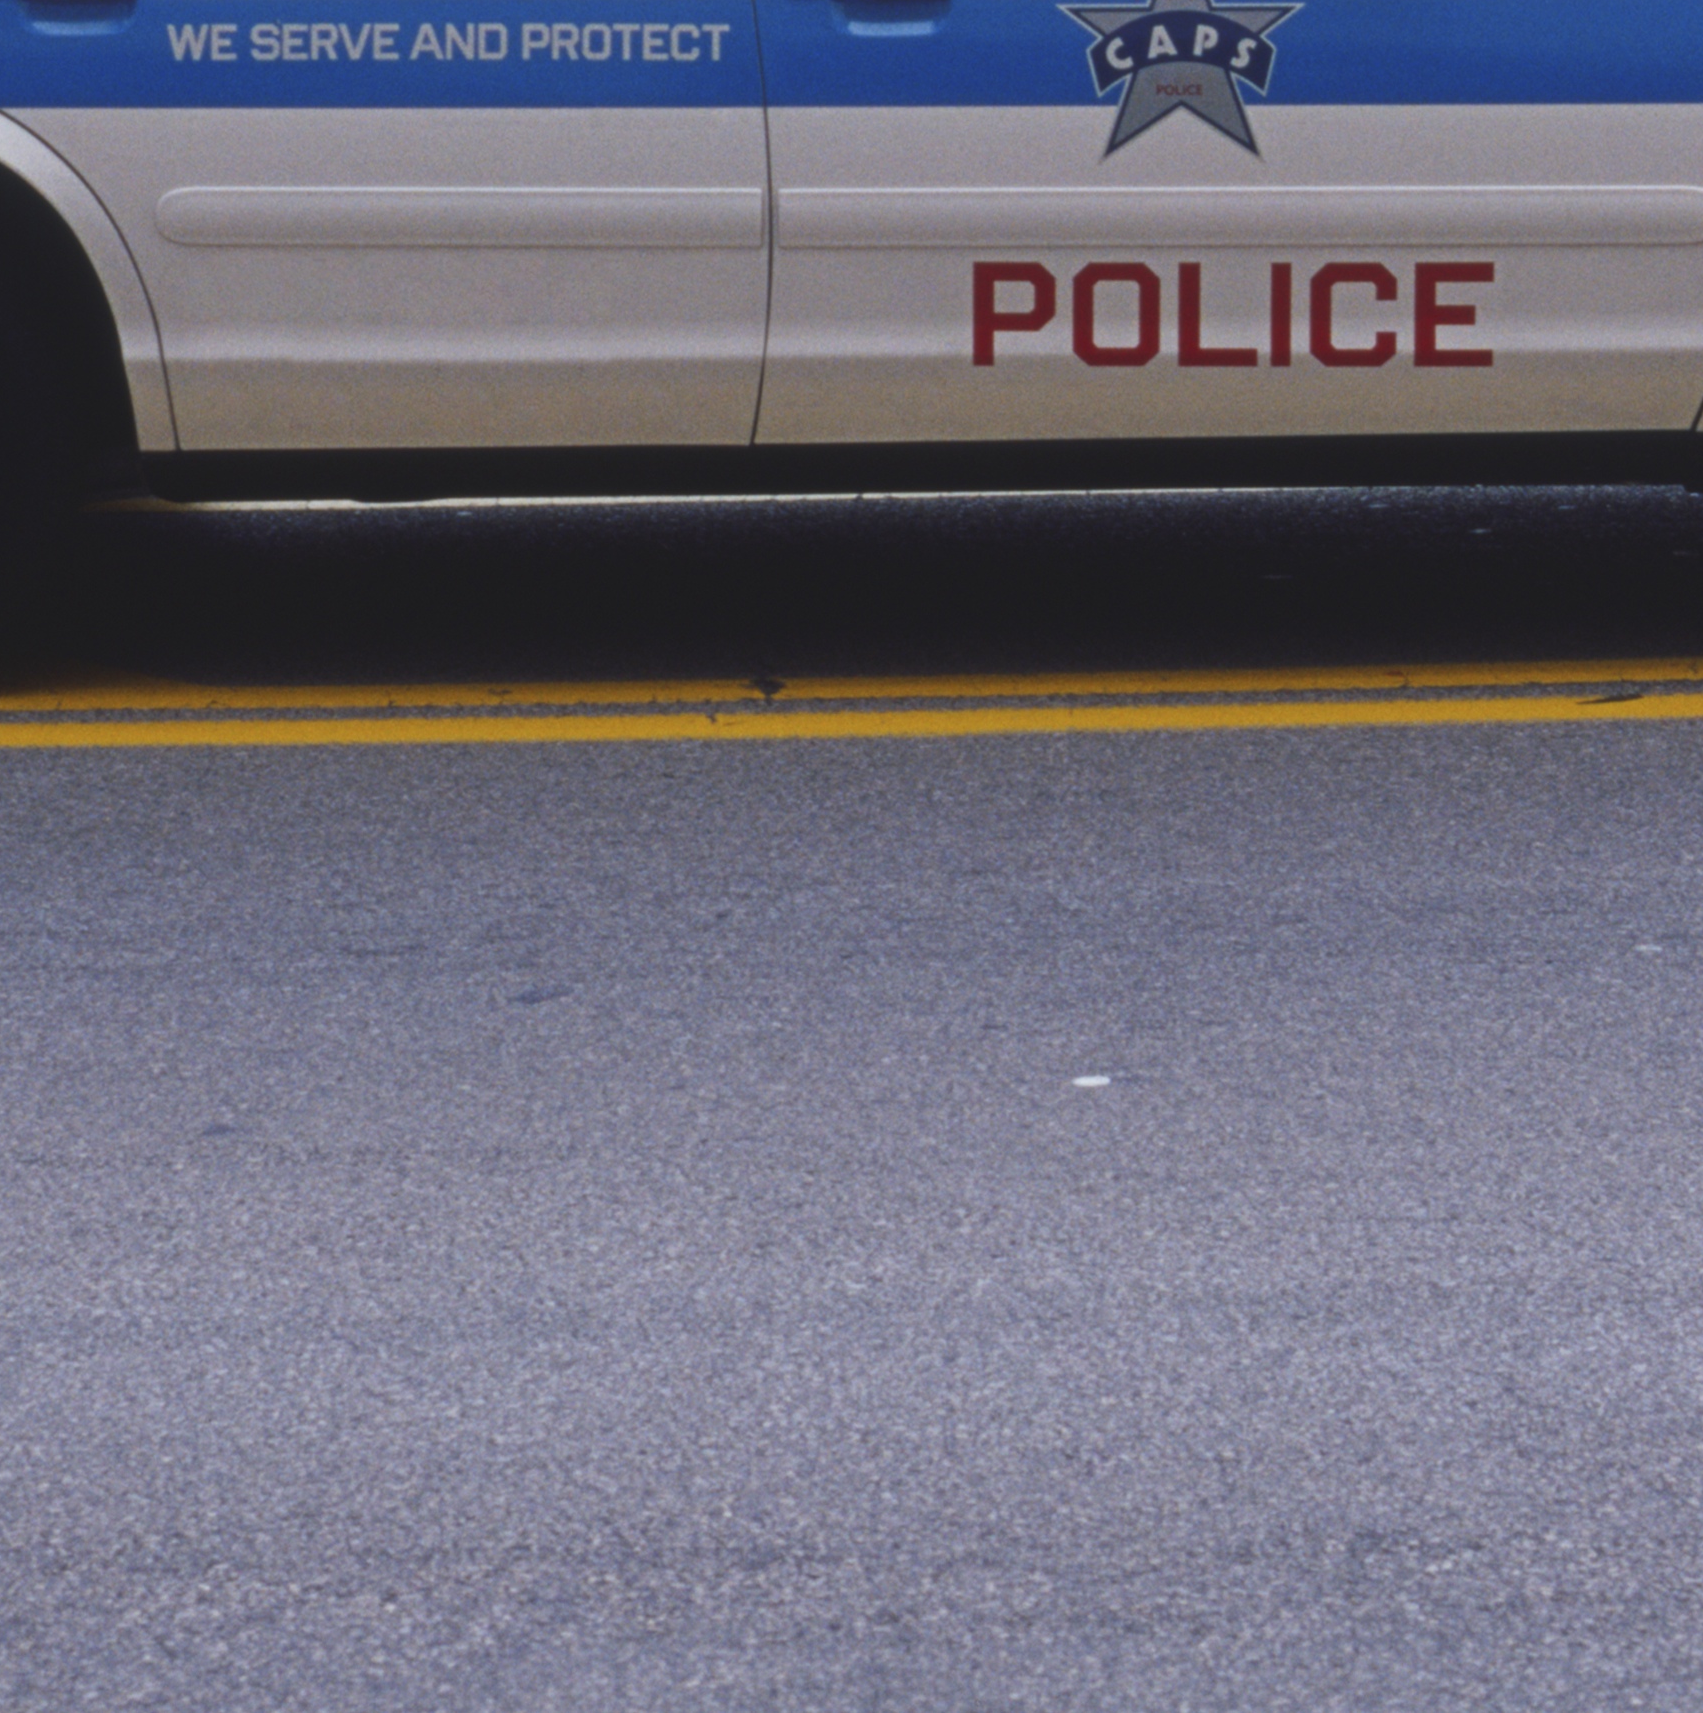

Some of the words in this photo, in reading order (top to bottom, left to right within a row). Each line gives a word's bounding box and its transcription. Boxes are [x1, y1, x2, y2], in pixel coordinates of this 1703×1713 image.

[167, 23, 238, 61] WE
[250, 23, 400, 61] SERVE
[409, 23, 509, 61] AND
[521, 23, 730, 61] PROTECT
[1105, 24, 1257, 70] CAPS
[1155, 84, 1203, 96] POLICE
[973, 262, 1494, 367] POLICE
